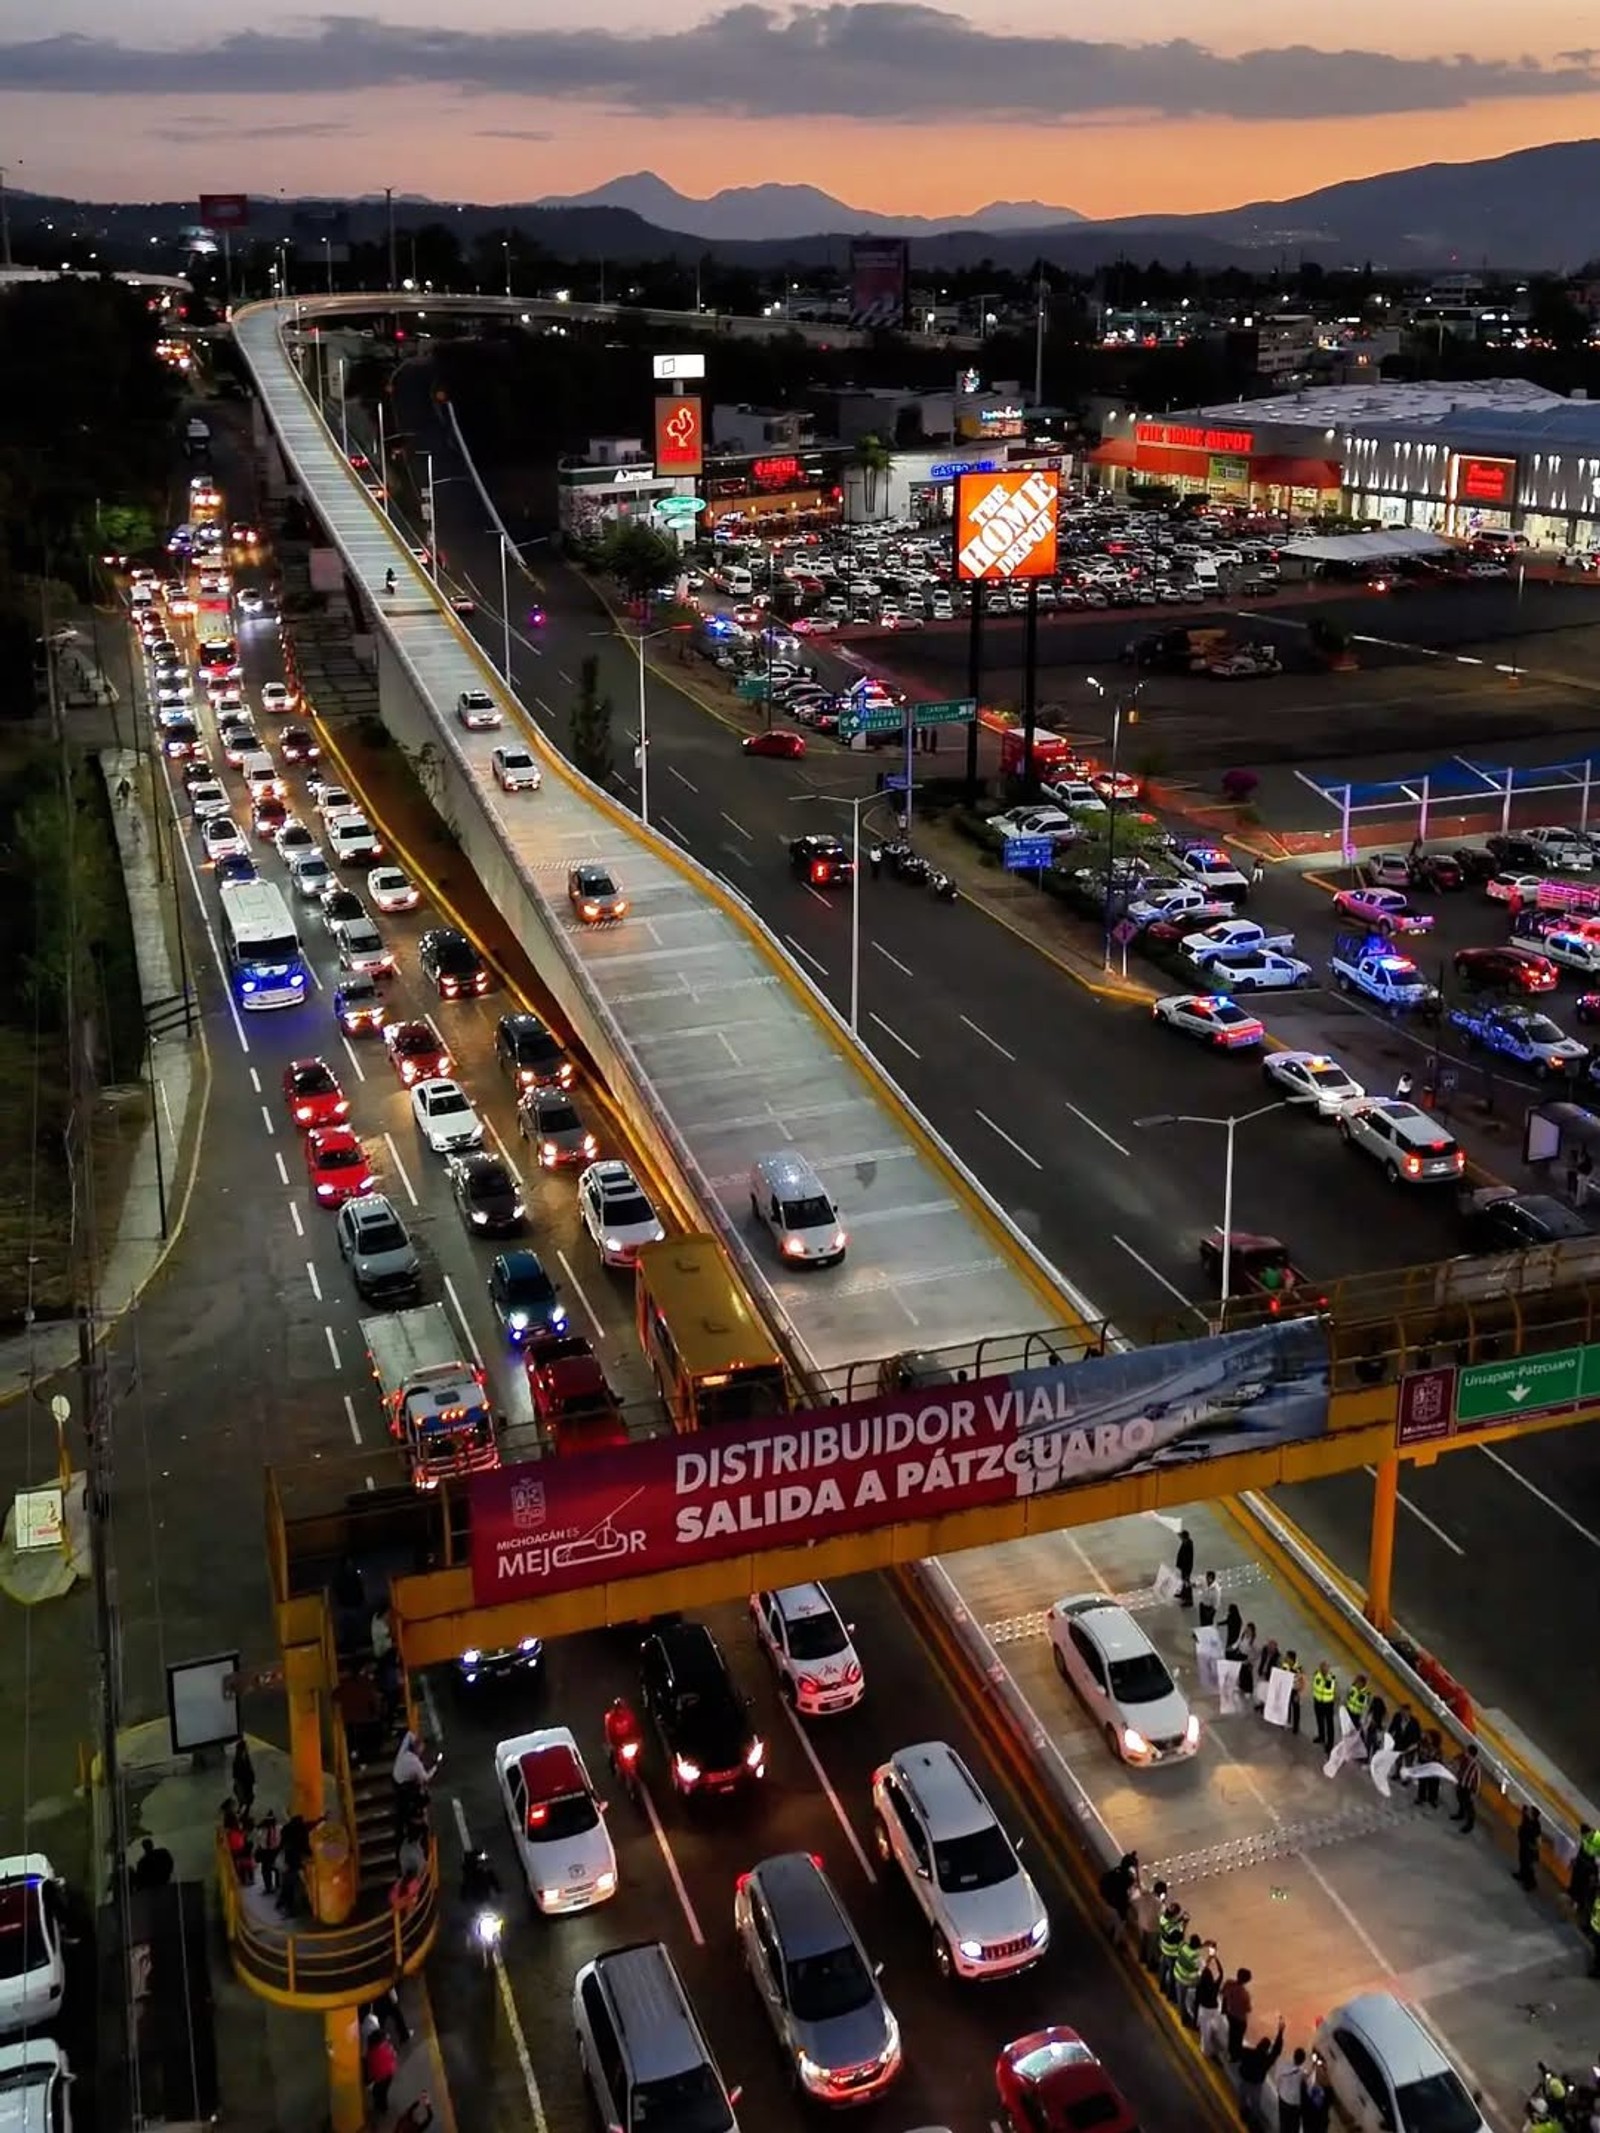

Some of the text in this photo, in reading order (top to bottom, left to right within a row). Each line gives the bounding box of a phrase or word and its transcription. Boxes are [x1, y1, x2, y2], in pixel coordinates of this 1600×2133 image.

[932, 463, 969, 476] GASTRO
[959, 471, 1058, 578] HOME
[968, 483, 1012, 526] THE
[995, 508, 1055, 577] DEPOT
[675, 1382, 1075, 1495] DISTRIBUIDOR VIAL
[675, 1418, 1155, 1543] SALIDA A PÁTZCUARO
[496, 1527, 580, 1551] MICHOACÁN ES
